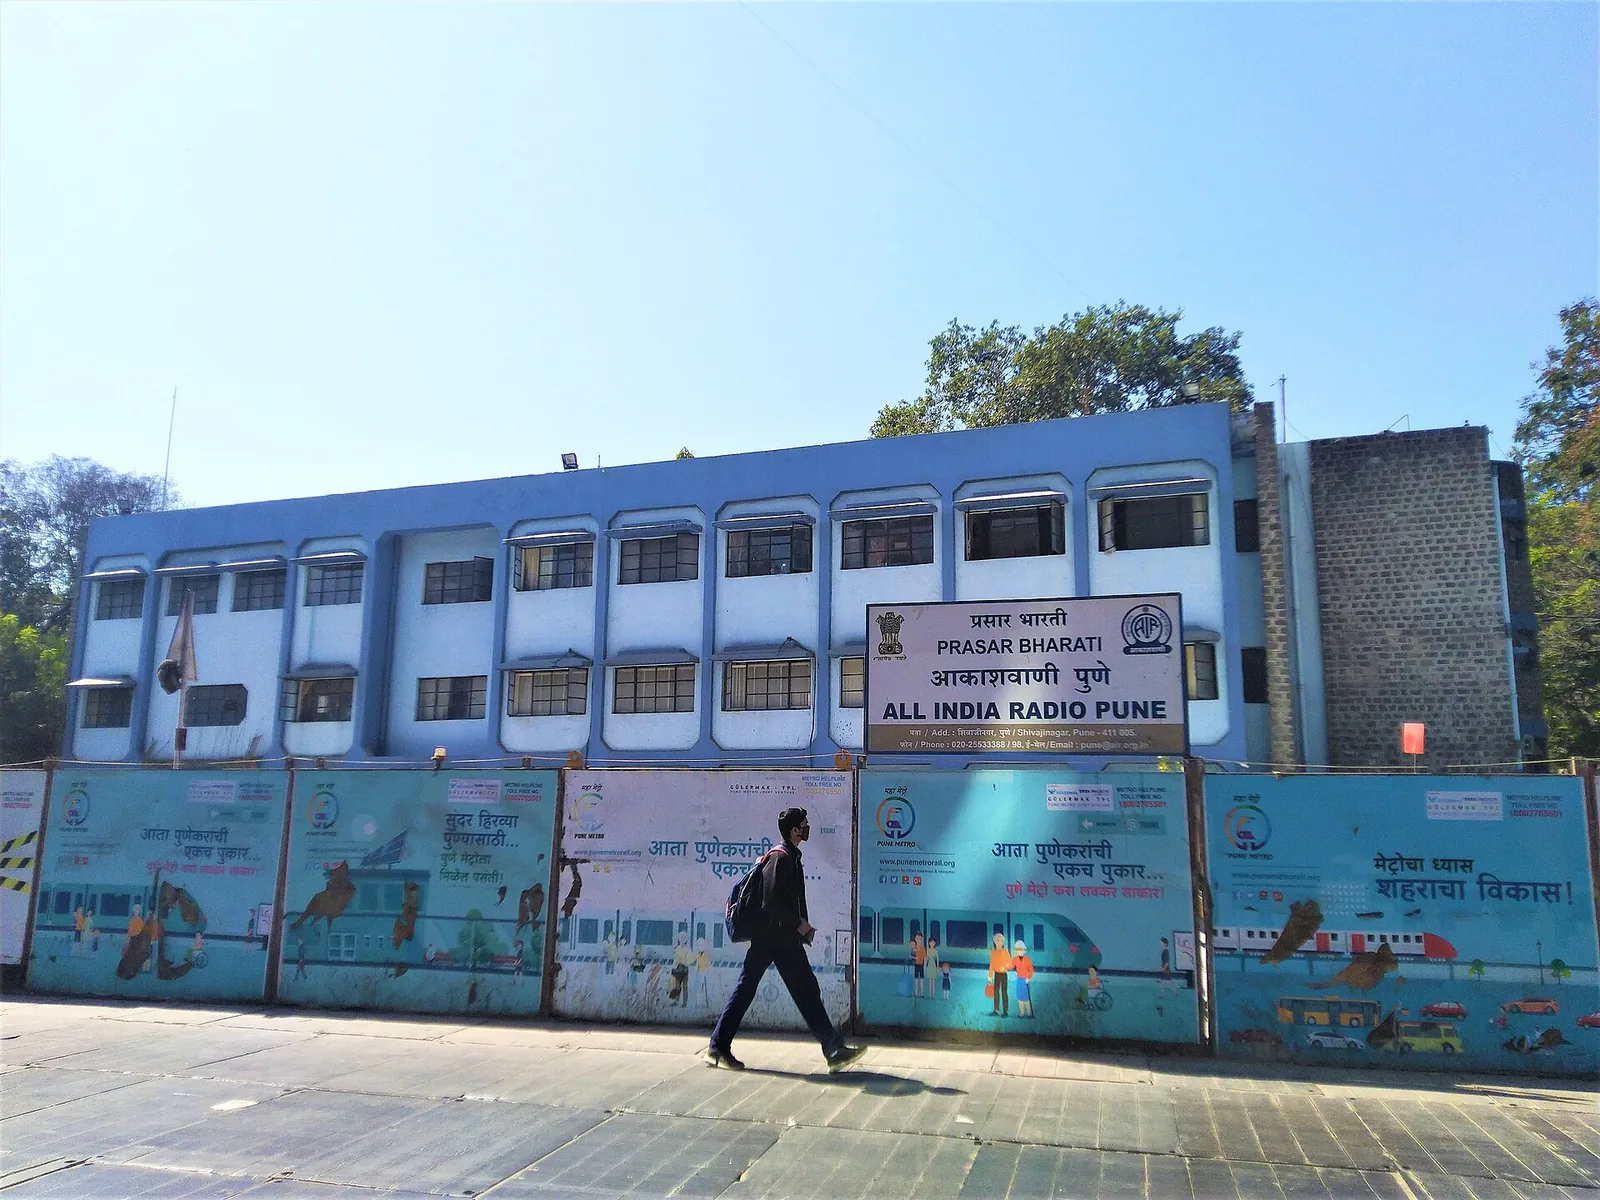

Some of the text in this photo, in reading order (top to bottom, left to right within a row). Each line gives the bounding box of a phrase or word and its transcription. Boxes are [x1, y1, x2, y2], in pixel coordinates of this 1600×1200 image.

[969, 608, 1068, 629] प्रसार भारती
[937, 636, 1102, 656] PRASAR BHARATI
[930, 659, 1112, 694] आकाशवाणी पुणे
[882, 700, 1167, 720] ALL INDIA RADIO PUNE
[446, 809, 474, 831] सुंदर
[141, 828, 171, 841] आता
[648, 841, 688, 856] आता
[992, 838, 1113, 864] आता पुणेकरांची
[879, 858, 956, 868] www.punemetrorail.org
[1053, 862, 1094, 880] एकच
[1374, 852, 1475, 876] मेट्रोचा ध्यास
[1006, 880, 1023, 899] पुणे
[1027, 880, 1049, 899] मेट्रो
[1053, 885, 1076, 897] करा
[1376, 878, 1467, 902] शहराचा
